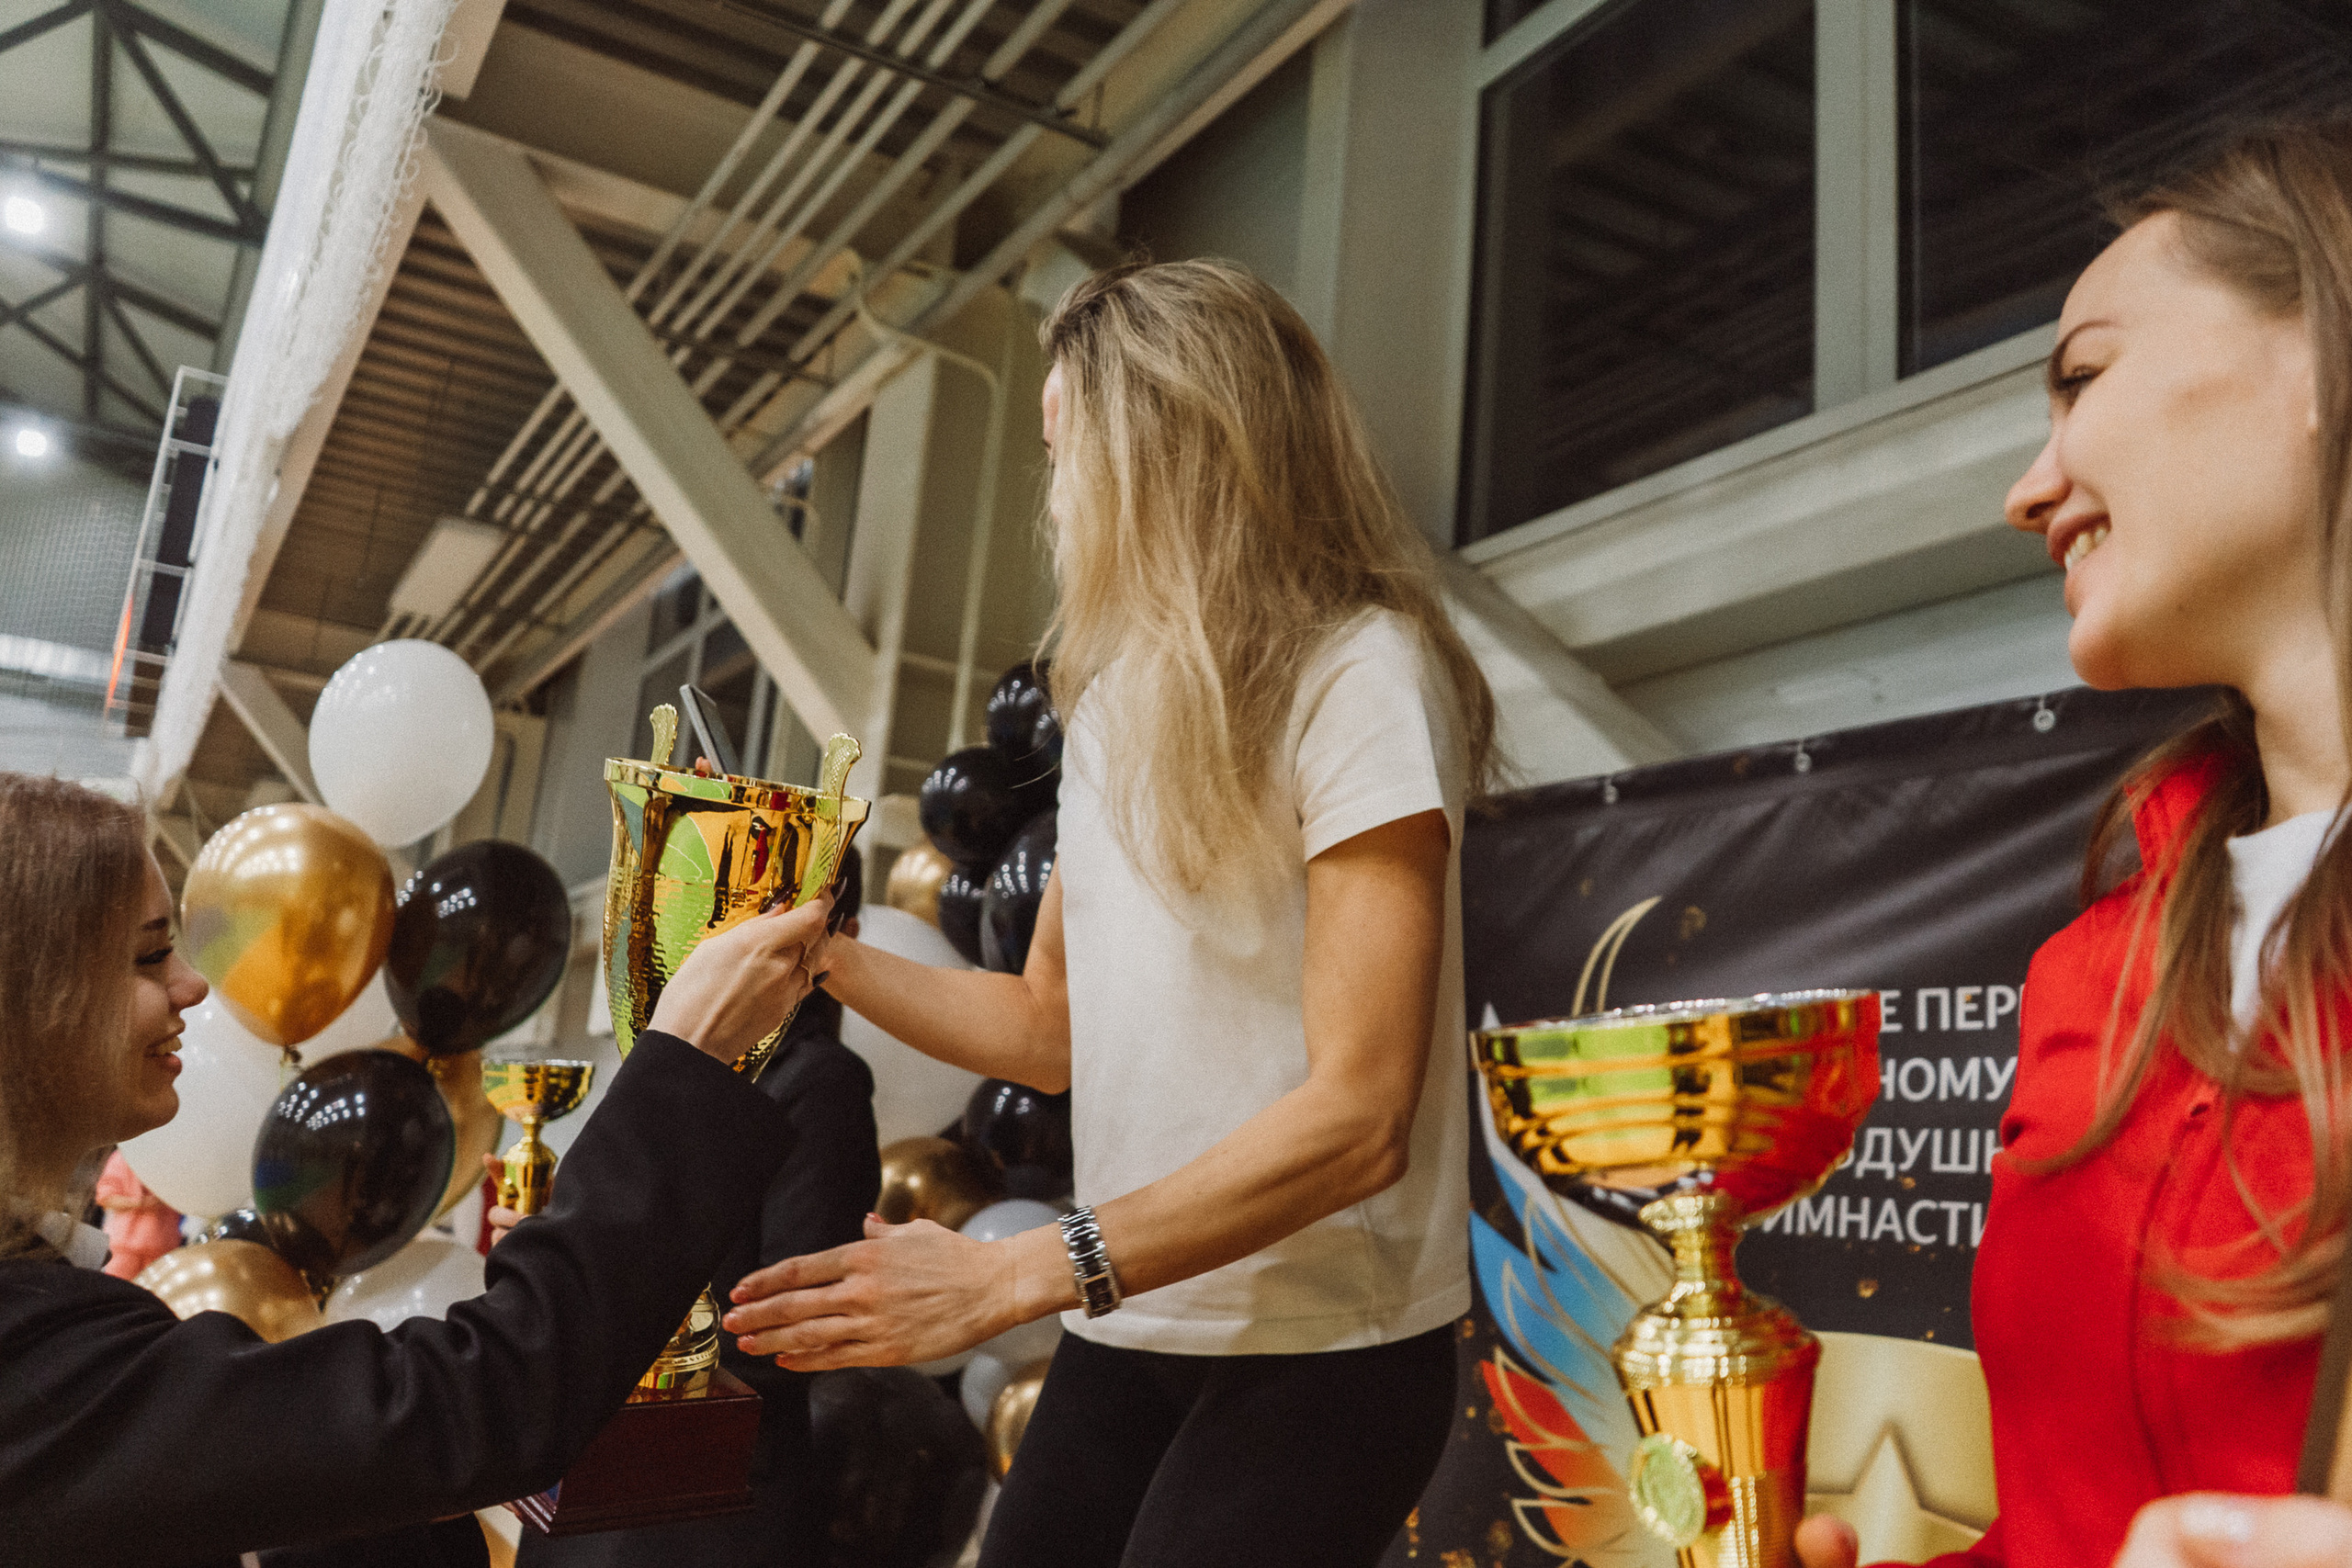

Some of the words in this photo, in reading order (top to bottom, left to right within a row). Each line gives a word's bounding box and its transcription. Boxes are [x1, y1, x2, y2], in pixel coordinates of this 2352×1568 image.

[1917, 985, 2025, 1032] ПЕР
[1838, 1127, 2005, 1179] ДУШ
[1743, 1194, 1987, 1247] ИМНАСТ
